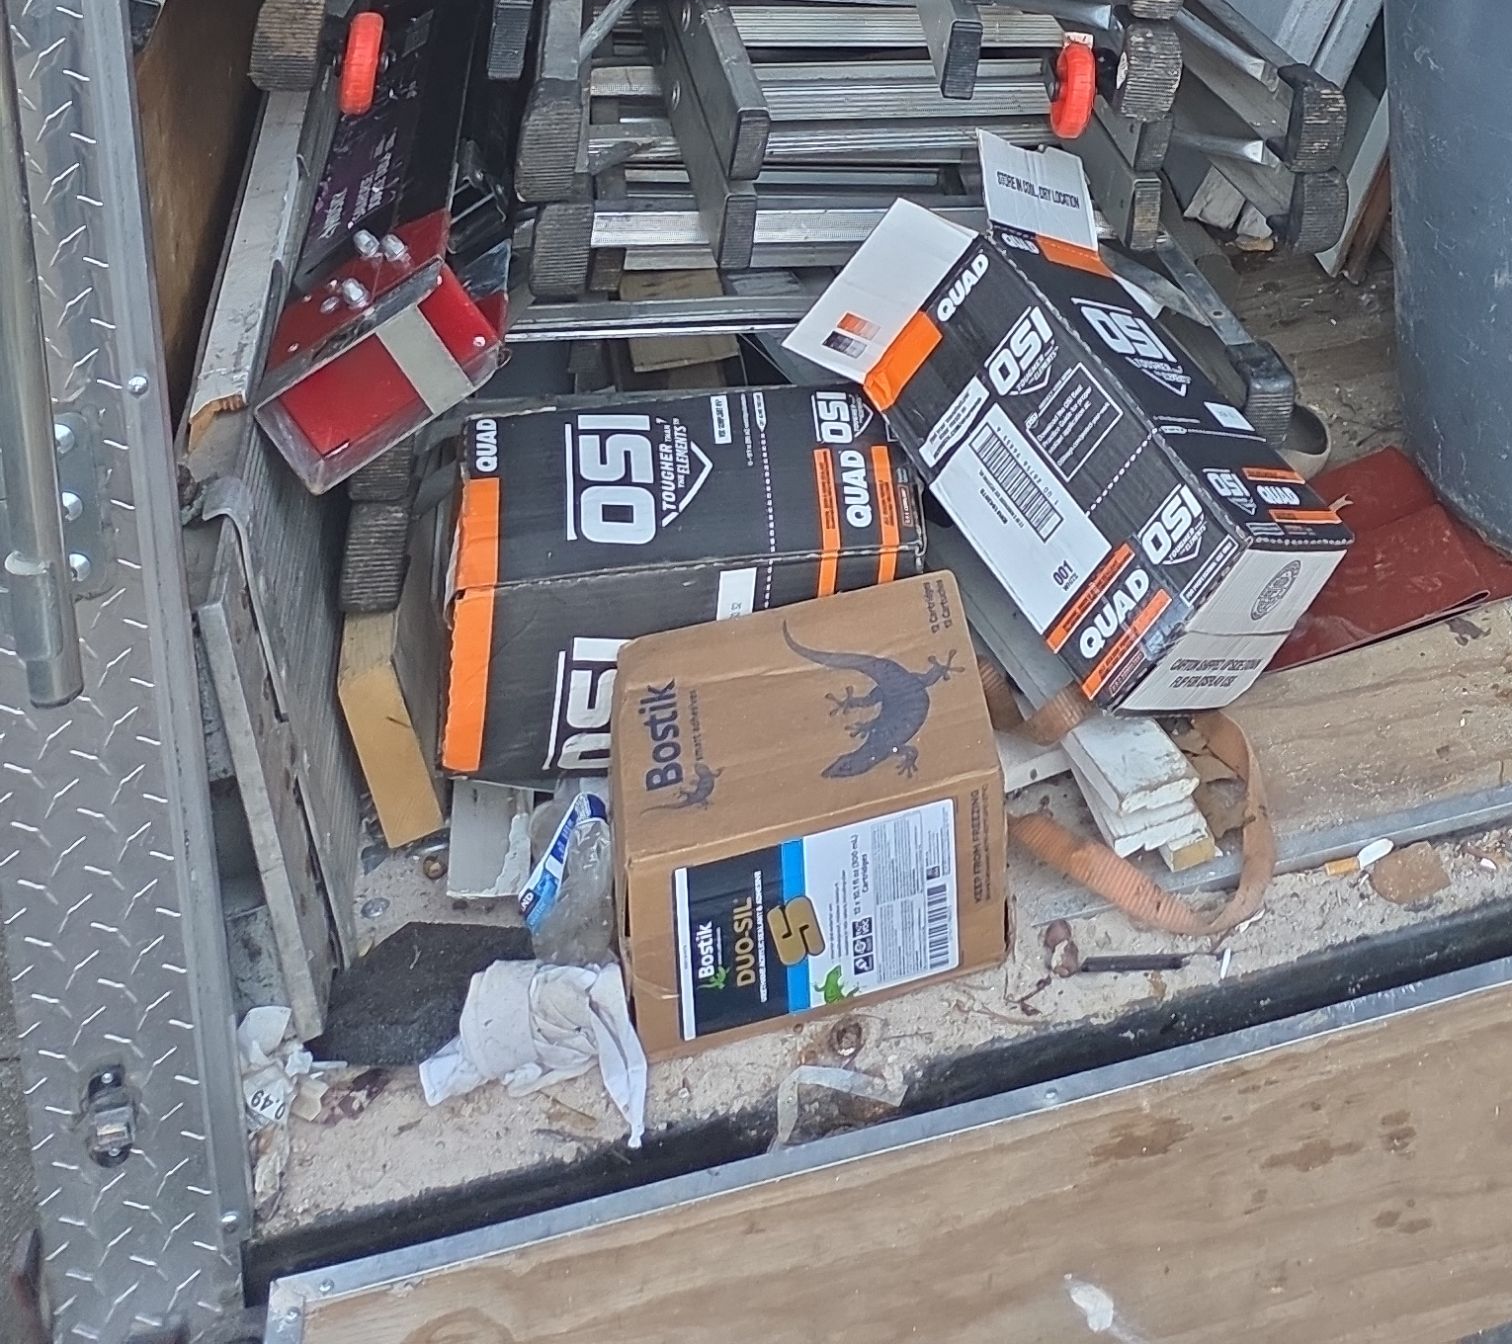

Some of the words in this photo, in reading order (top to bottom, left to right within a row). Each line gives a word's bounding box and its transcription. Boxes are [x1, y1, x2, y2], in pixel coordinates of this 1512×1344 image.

[937, 252, 990, 322] QUAD
[988, 306, 1054, 397] OSI
[1082, 306, 1178, 361] OSI
[475, 418, 498, 473] QUAD
[816, 392, 852, 441] OSI
[578, 414, 656, 545] OSI
[661, 444, 676, 512] TOUGHER
[841, 451, 872, 526] QUAD
[1205, 473, 1250, 498] OSI
[1256, 485, 1300, 505] QUAD
[1140, 484, 1203, 565] OSI
[1052, 561, 1073, 587] 001
[1079, 567, 1150, 660] QUAD
[639, 678, 684, 791] Bostik
[970, 789, 981, 842] FREEZING
[973, 844, 982, 875] FROM
[973, 878, 983, 904] KEEP
[698, 920, 714, 980] Bostik
[733, 896, 757, 987] DUO-SIL
